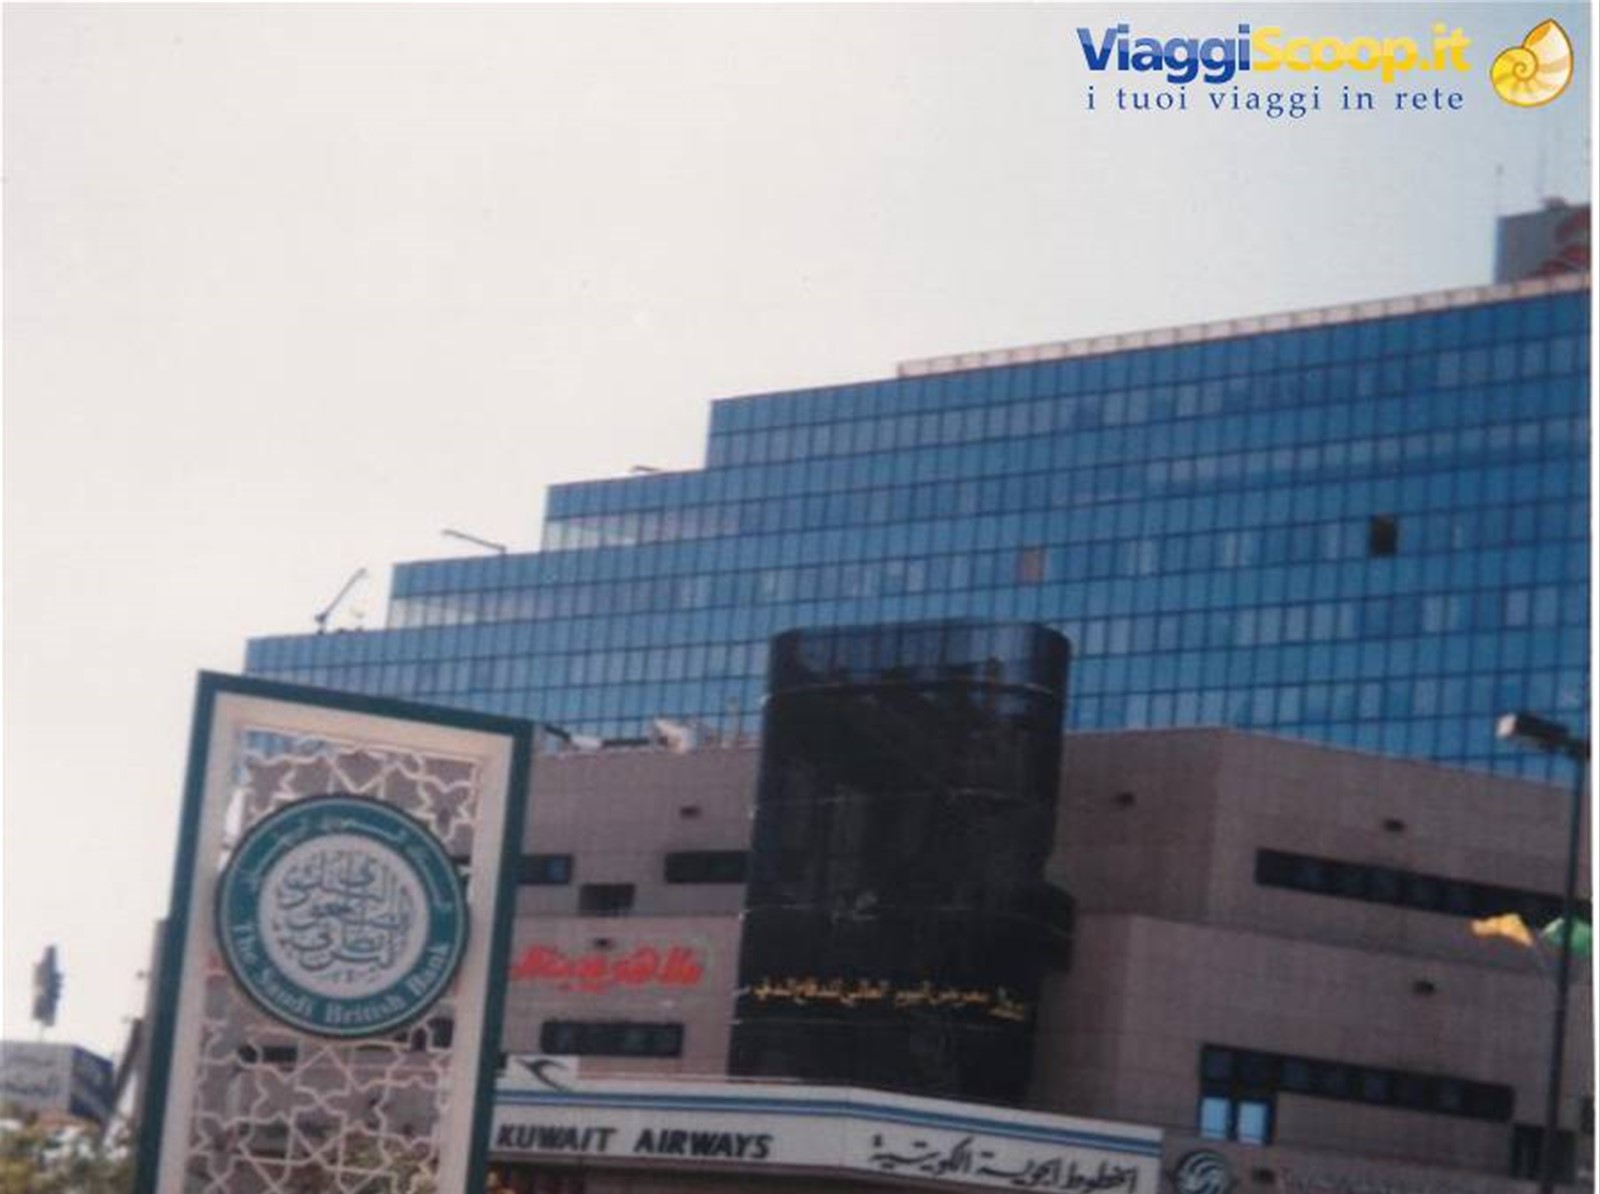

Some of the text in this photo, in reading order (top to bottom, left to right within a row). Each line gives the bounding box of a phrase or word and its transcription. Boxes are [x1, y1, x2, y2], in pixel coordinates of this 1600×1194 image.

[260, 968, 315, 1017] Saudi
[325, 994, 408, 1024] British
[405, 944, 451, 997] Bank
[496, 1123, 774, 1160] KUWAIT AIRWAYS
